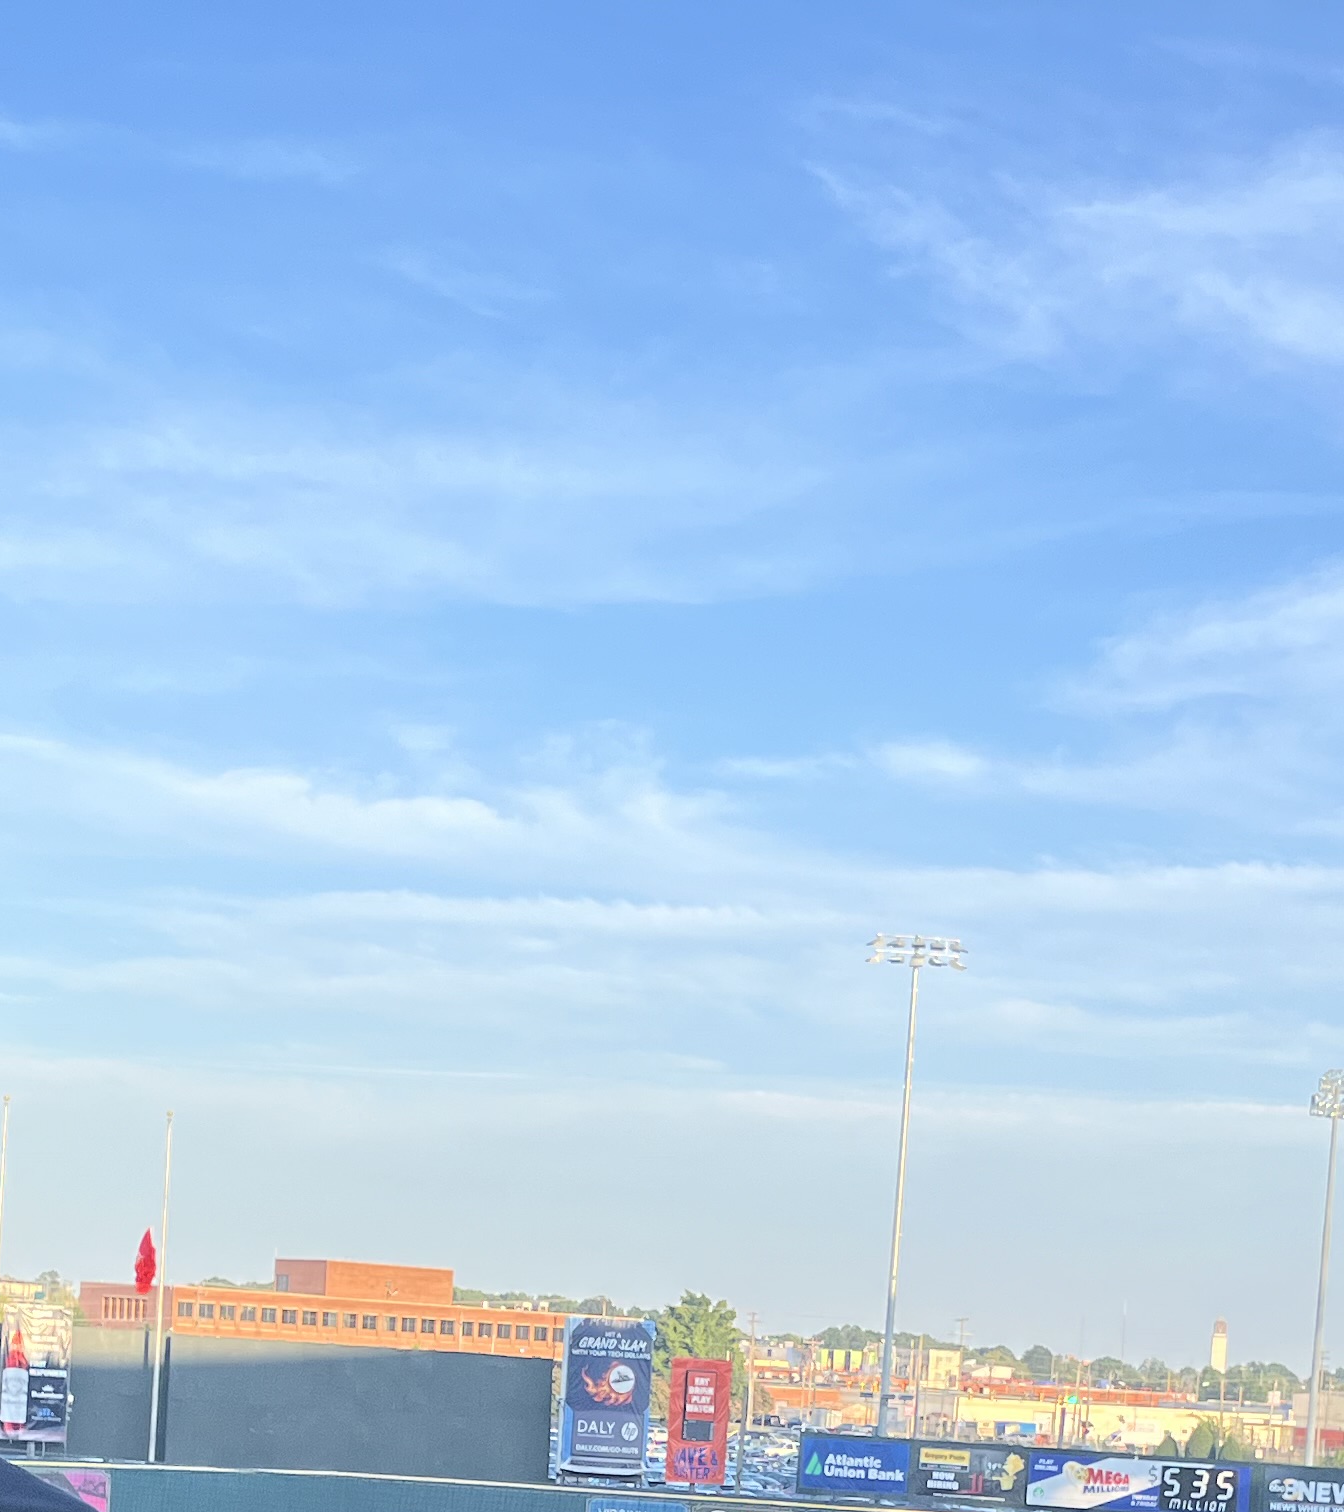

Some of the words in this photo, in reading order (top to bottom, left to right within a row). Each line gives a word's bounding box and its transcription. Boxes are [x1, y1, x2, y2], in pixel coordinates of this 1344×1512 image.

[579, 1337, 617, 1350] GRAND
[620, 1338, 648, 1351] SLAM
[577, 1420, 615, 1434] DALY
[824, 1453, 882, 1468] Atlantic
[823, 1464, 865, 1479] Union
[867, 1467, 904, 1482] Bank
[1163, 1467, 1234, 1501] 535
[1168, 1500, 1227, 1512] MILLION
[1269, 1502, 1296, 1512] NEWS
